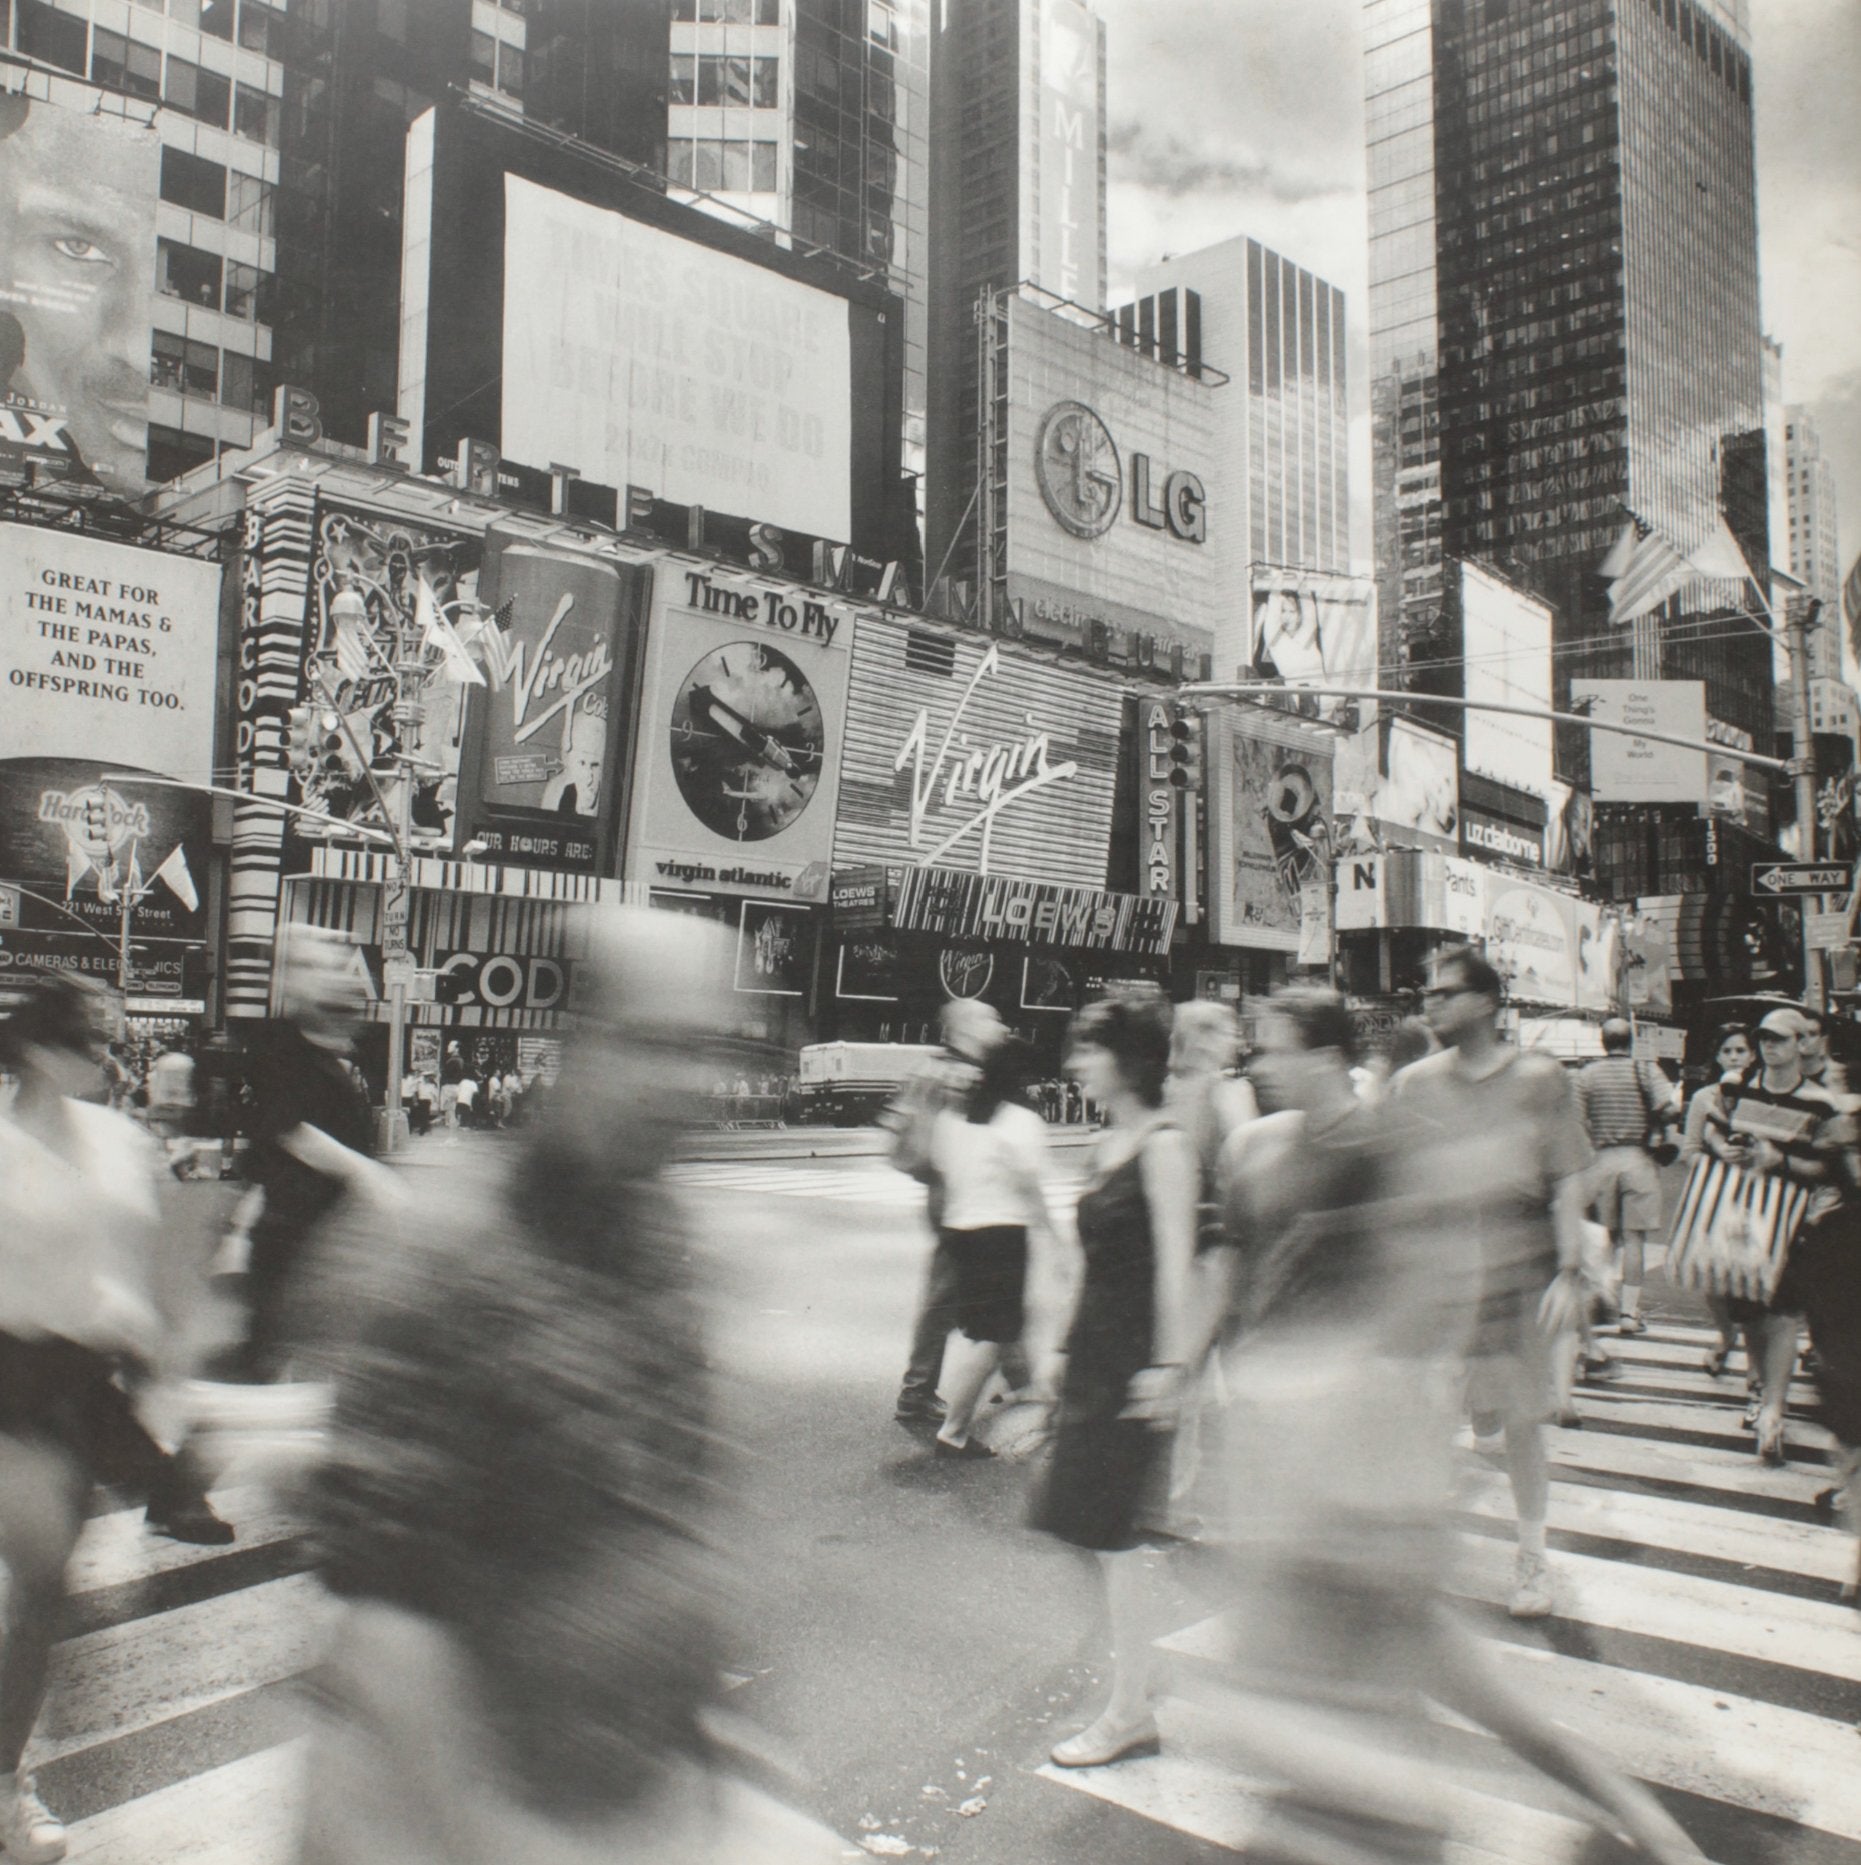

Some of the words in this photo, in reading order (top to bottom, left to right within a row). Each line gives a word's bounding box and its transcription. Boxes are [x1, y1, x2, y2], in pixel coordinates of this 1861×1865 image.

[1131, 452, 1206, 543] LG
[41, 569, 112, 597] GREAT
[119, 583, 159, 605] FOR
[25, 591, 67, 614] THE
[75, 601, 152, 629] MAMAS
[159, 617, 172, 632] &
[685, 572, 758, 620] Time
[763, 590, 797, 630] To
[802, 601, 839, 647] Fly
[38, 620, 80, 642] THE
[87, 629, 157, 657] PAPAS,
[50, 650, 97, 671] AND
[104, 658, 145, 679] THE
[504, 592, 613, 753] Virgin
[9, 669, 129, 702] OFFSPRING
[138, 689, 184, 710] TOO.
[896, 640, 1078, 877] Virgin
[1147, 704, 1169, 779] ALL
[476, 831, 503, 850] OUR
[510, 834, 558, 856] HOURS
[565, 842, 593, 859] ARE:
[1147, 789, 1171, 892] STAR
[655, 859, 716, 882] virgin
[719, 867, 792, 889] atlantic
[833, 886, 875, 900] LOEWS
[1767, 873, 1796, 887] ONE
[1809, 873, 1840, 886] WAY
[83, 902, 113, 916] West
[137, 906, 171, 919] Street
[982, 893, 1117, 940] LOEWS
[15, 952, 78, 971] CAMERAS
[81, 955, 91, 971] &
